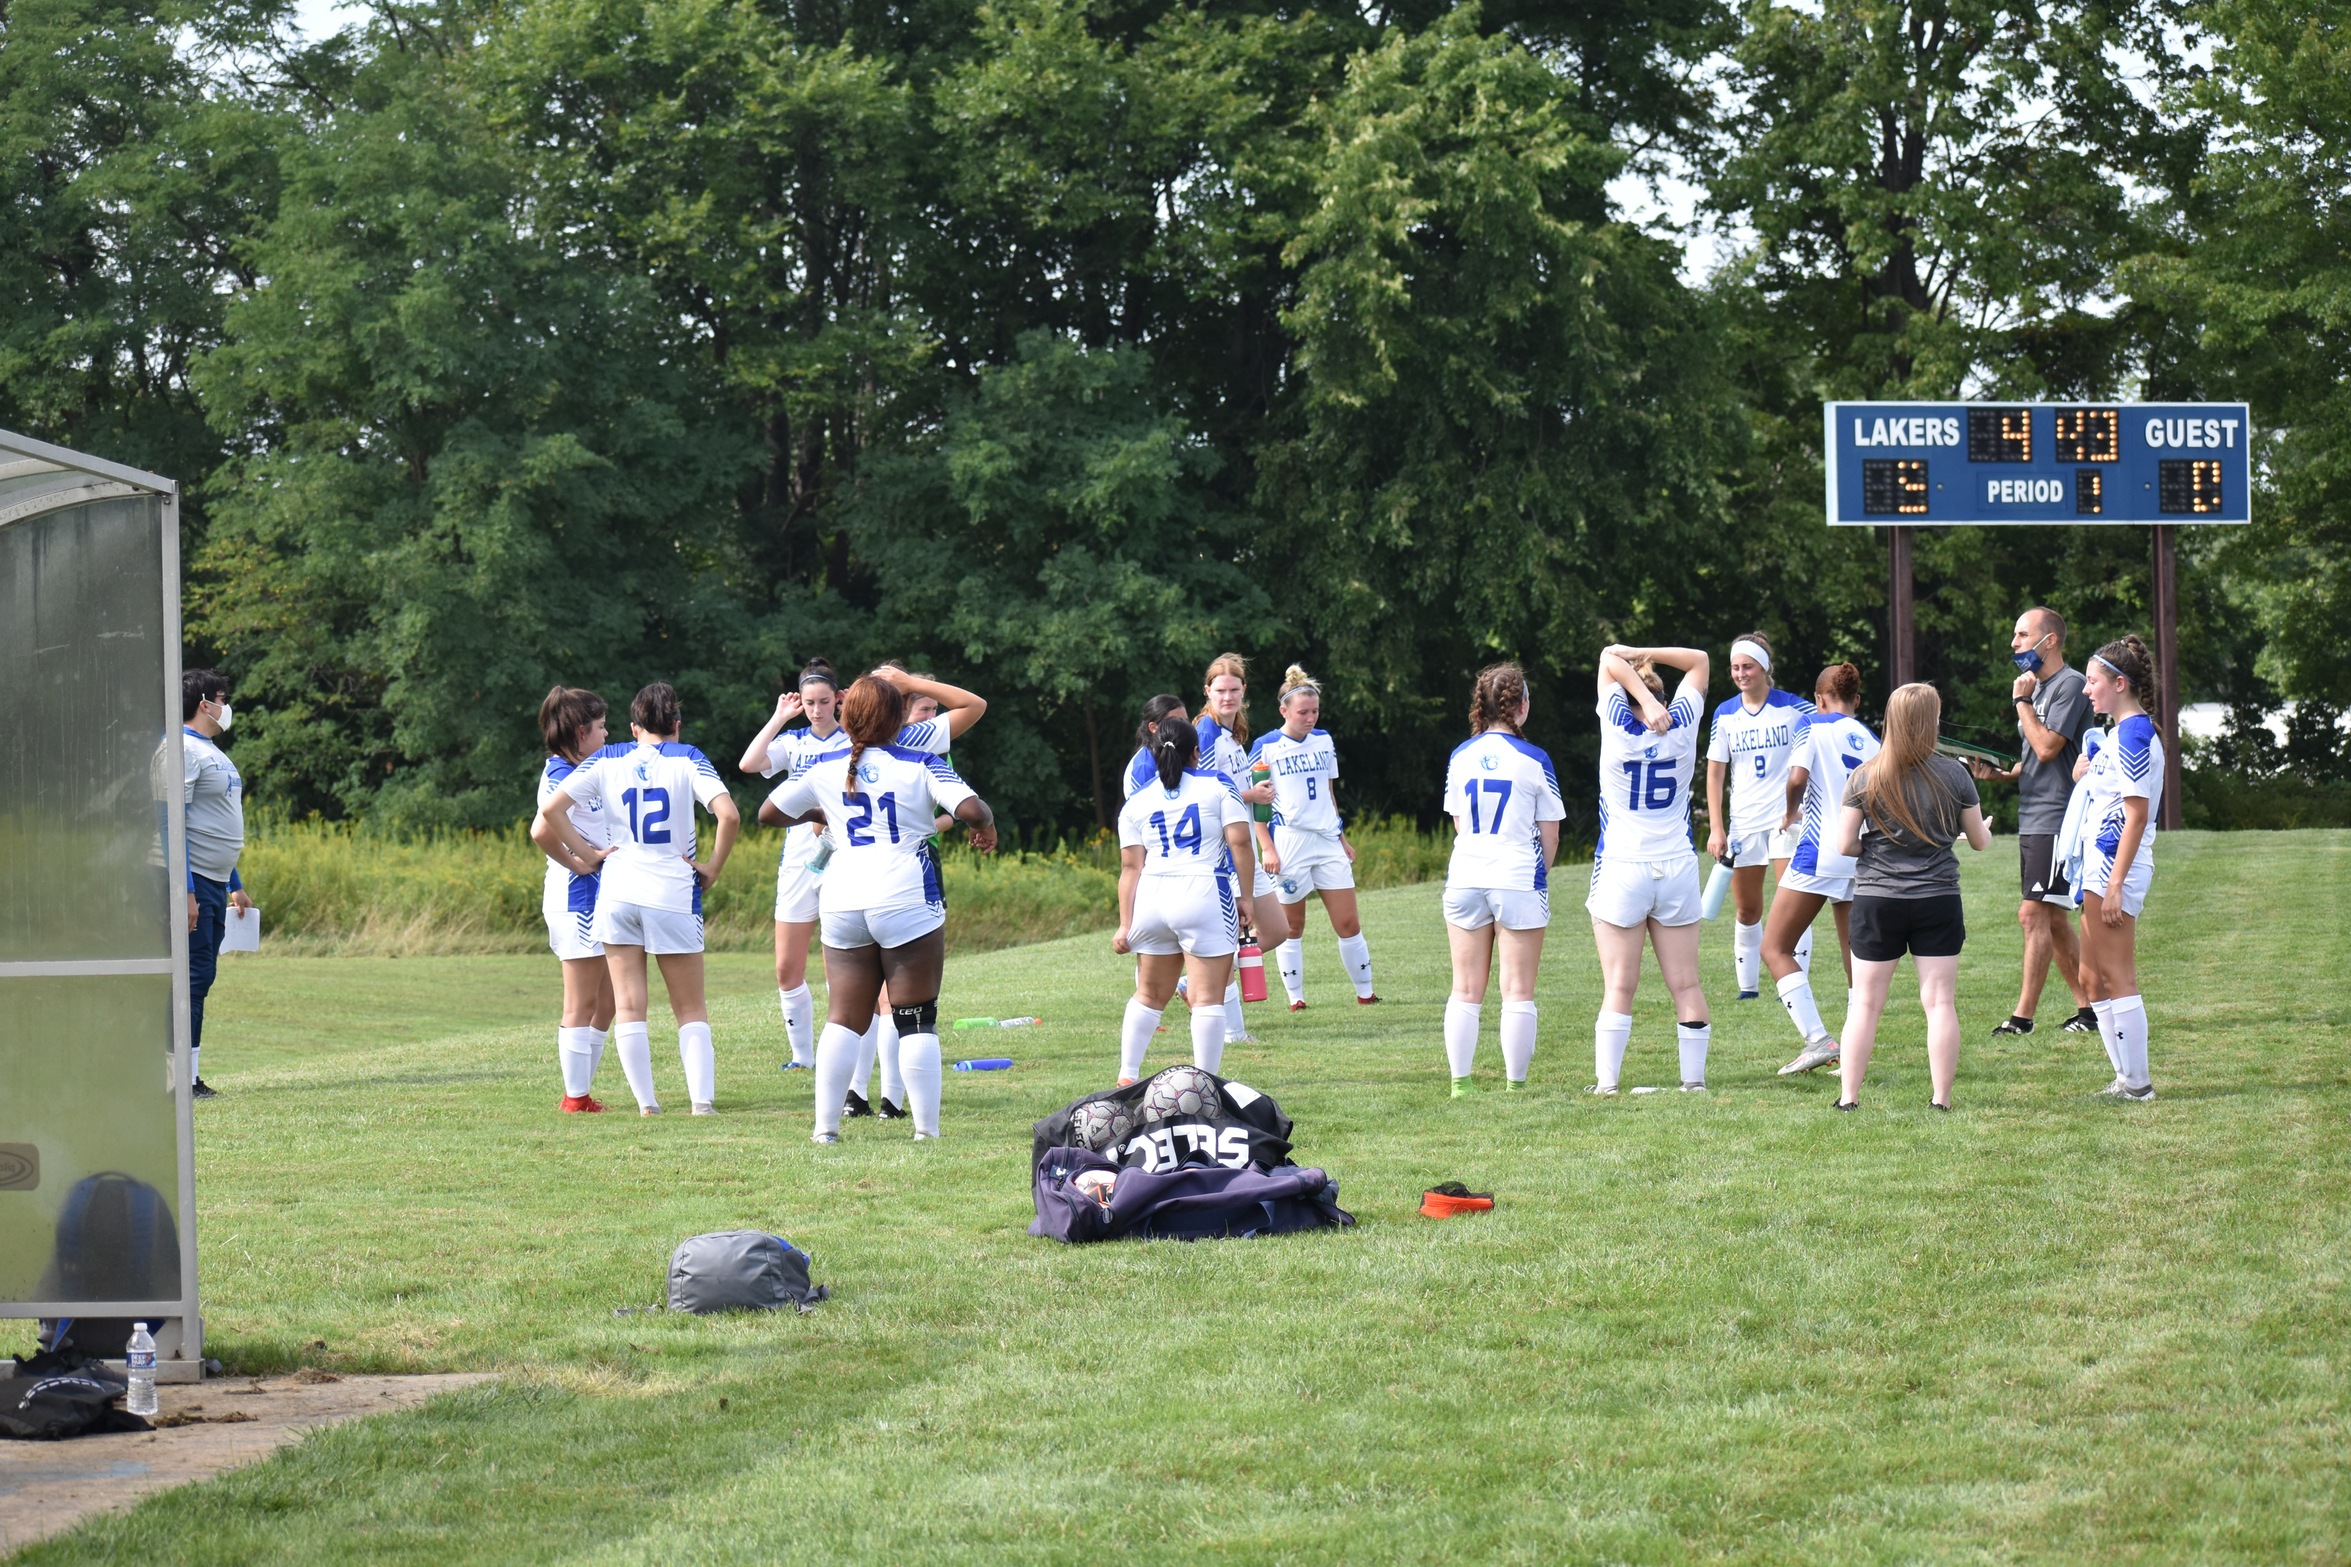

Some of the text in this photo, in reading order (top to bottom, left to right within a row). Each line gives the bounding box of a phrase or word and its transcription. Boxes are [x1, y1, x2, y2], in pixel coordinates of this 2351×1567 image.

[1854, 417, 1960, 447] LAKERS
[2145, 418, 2239, 448] GUEST
[1987, 480, 2064, 503] PERIOD
[1728, 725, 1789, 752] LAKELAND
[1623, 759, 1678, 811] 16
[1755, 755, 1766, 779] 9
[1307, 777, 1316, 800] 8
[1464, 778, 1512, 835] 17
[622, 787, 671, 844] 12
[842, 791, 901, 847] 21
[1149, 803, 1202, 858] 14
[1073, 1111, 1088, 1149] SELEC
[1106, 1124, 1249, 1174] SELEC
